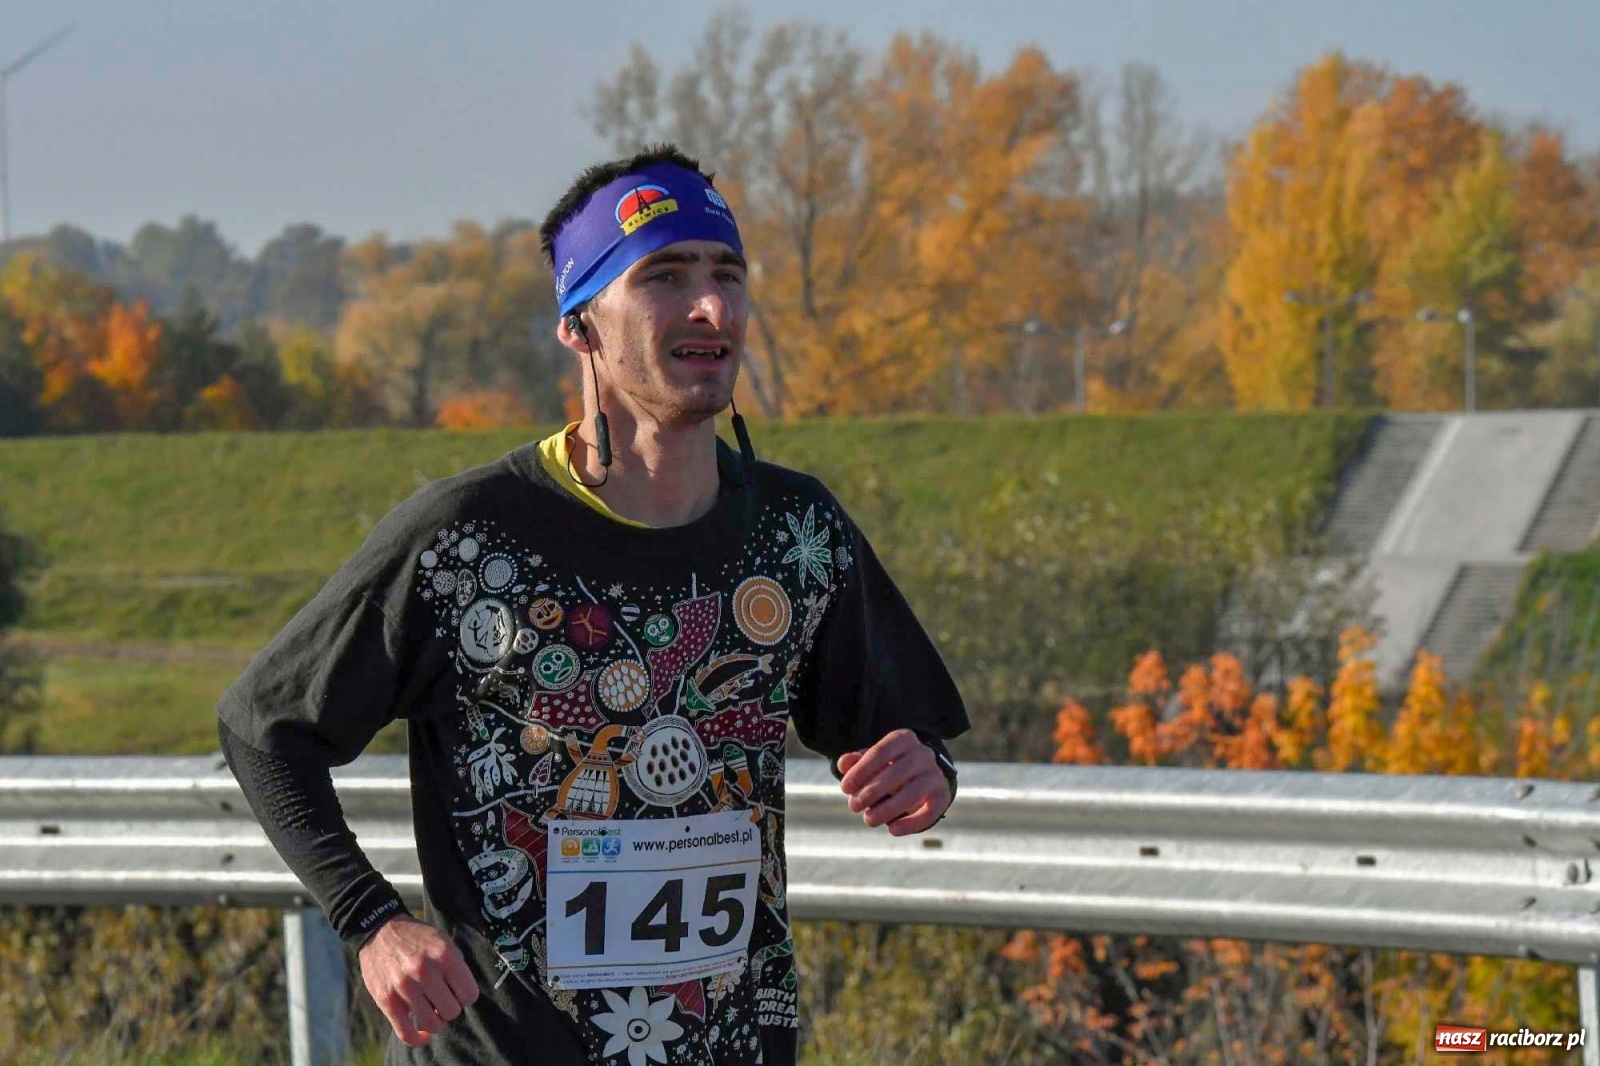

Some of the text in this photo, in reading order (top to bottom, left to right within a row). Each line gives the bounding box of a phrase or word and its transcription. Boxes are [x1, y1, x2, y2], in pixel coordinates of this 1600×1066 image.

[628, 206, 669, 227] GLIWICE
[633, 828, 753, 853] www.personalbest.pl
[565, 872, 747, 956] 145
[755, 988, 796, 1003] BIRTH
